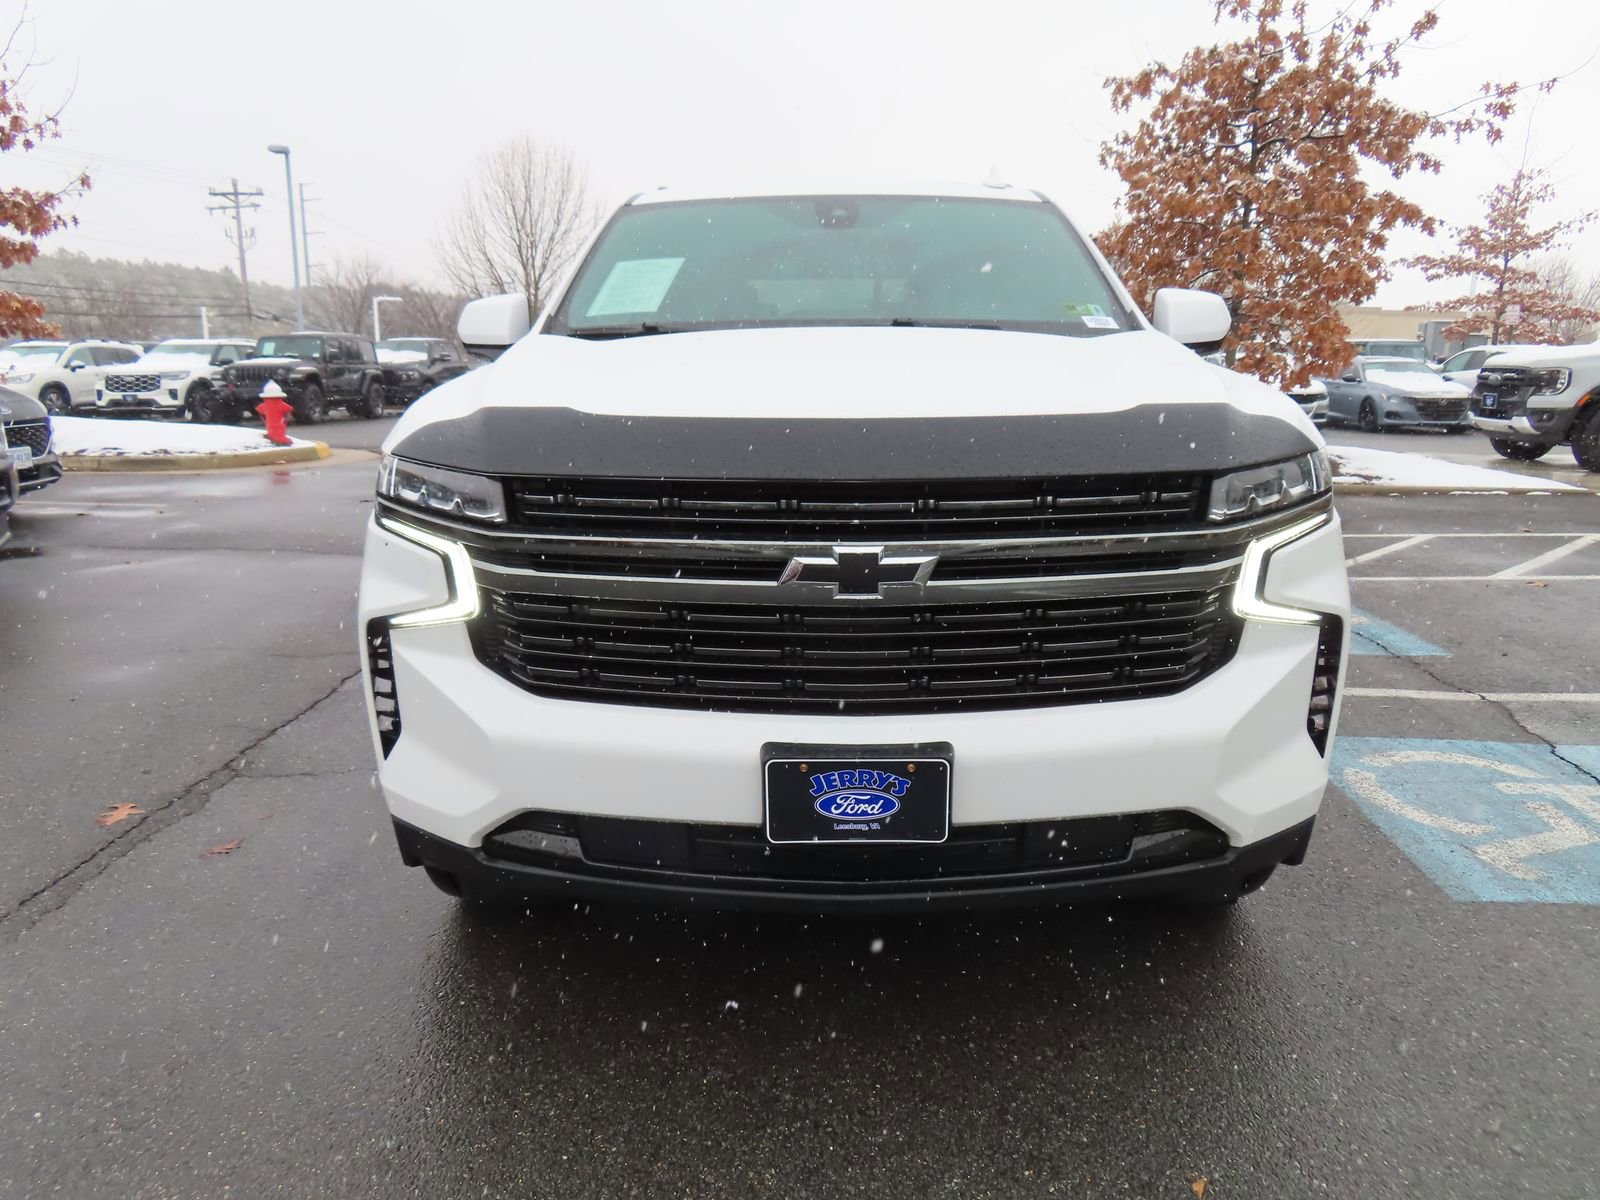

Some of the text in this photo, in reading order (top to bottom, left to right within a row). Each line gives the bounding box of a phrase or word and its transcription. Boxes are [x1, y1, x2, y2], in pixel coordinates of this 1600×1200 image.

[809, 769, 911, 796] JERRY'S
[831, 794, 884, 815] Ford
[869, 822, 881, 830] VA
